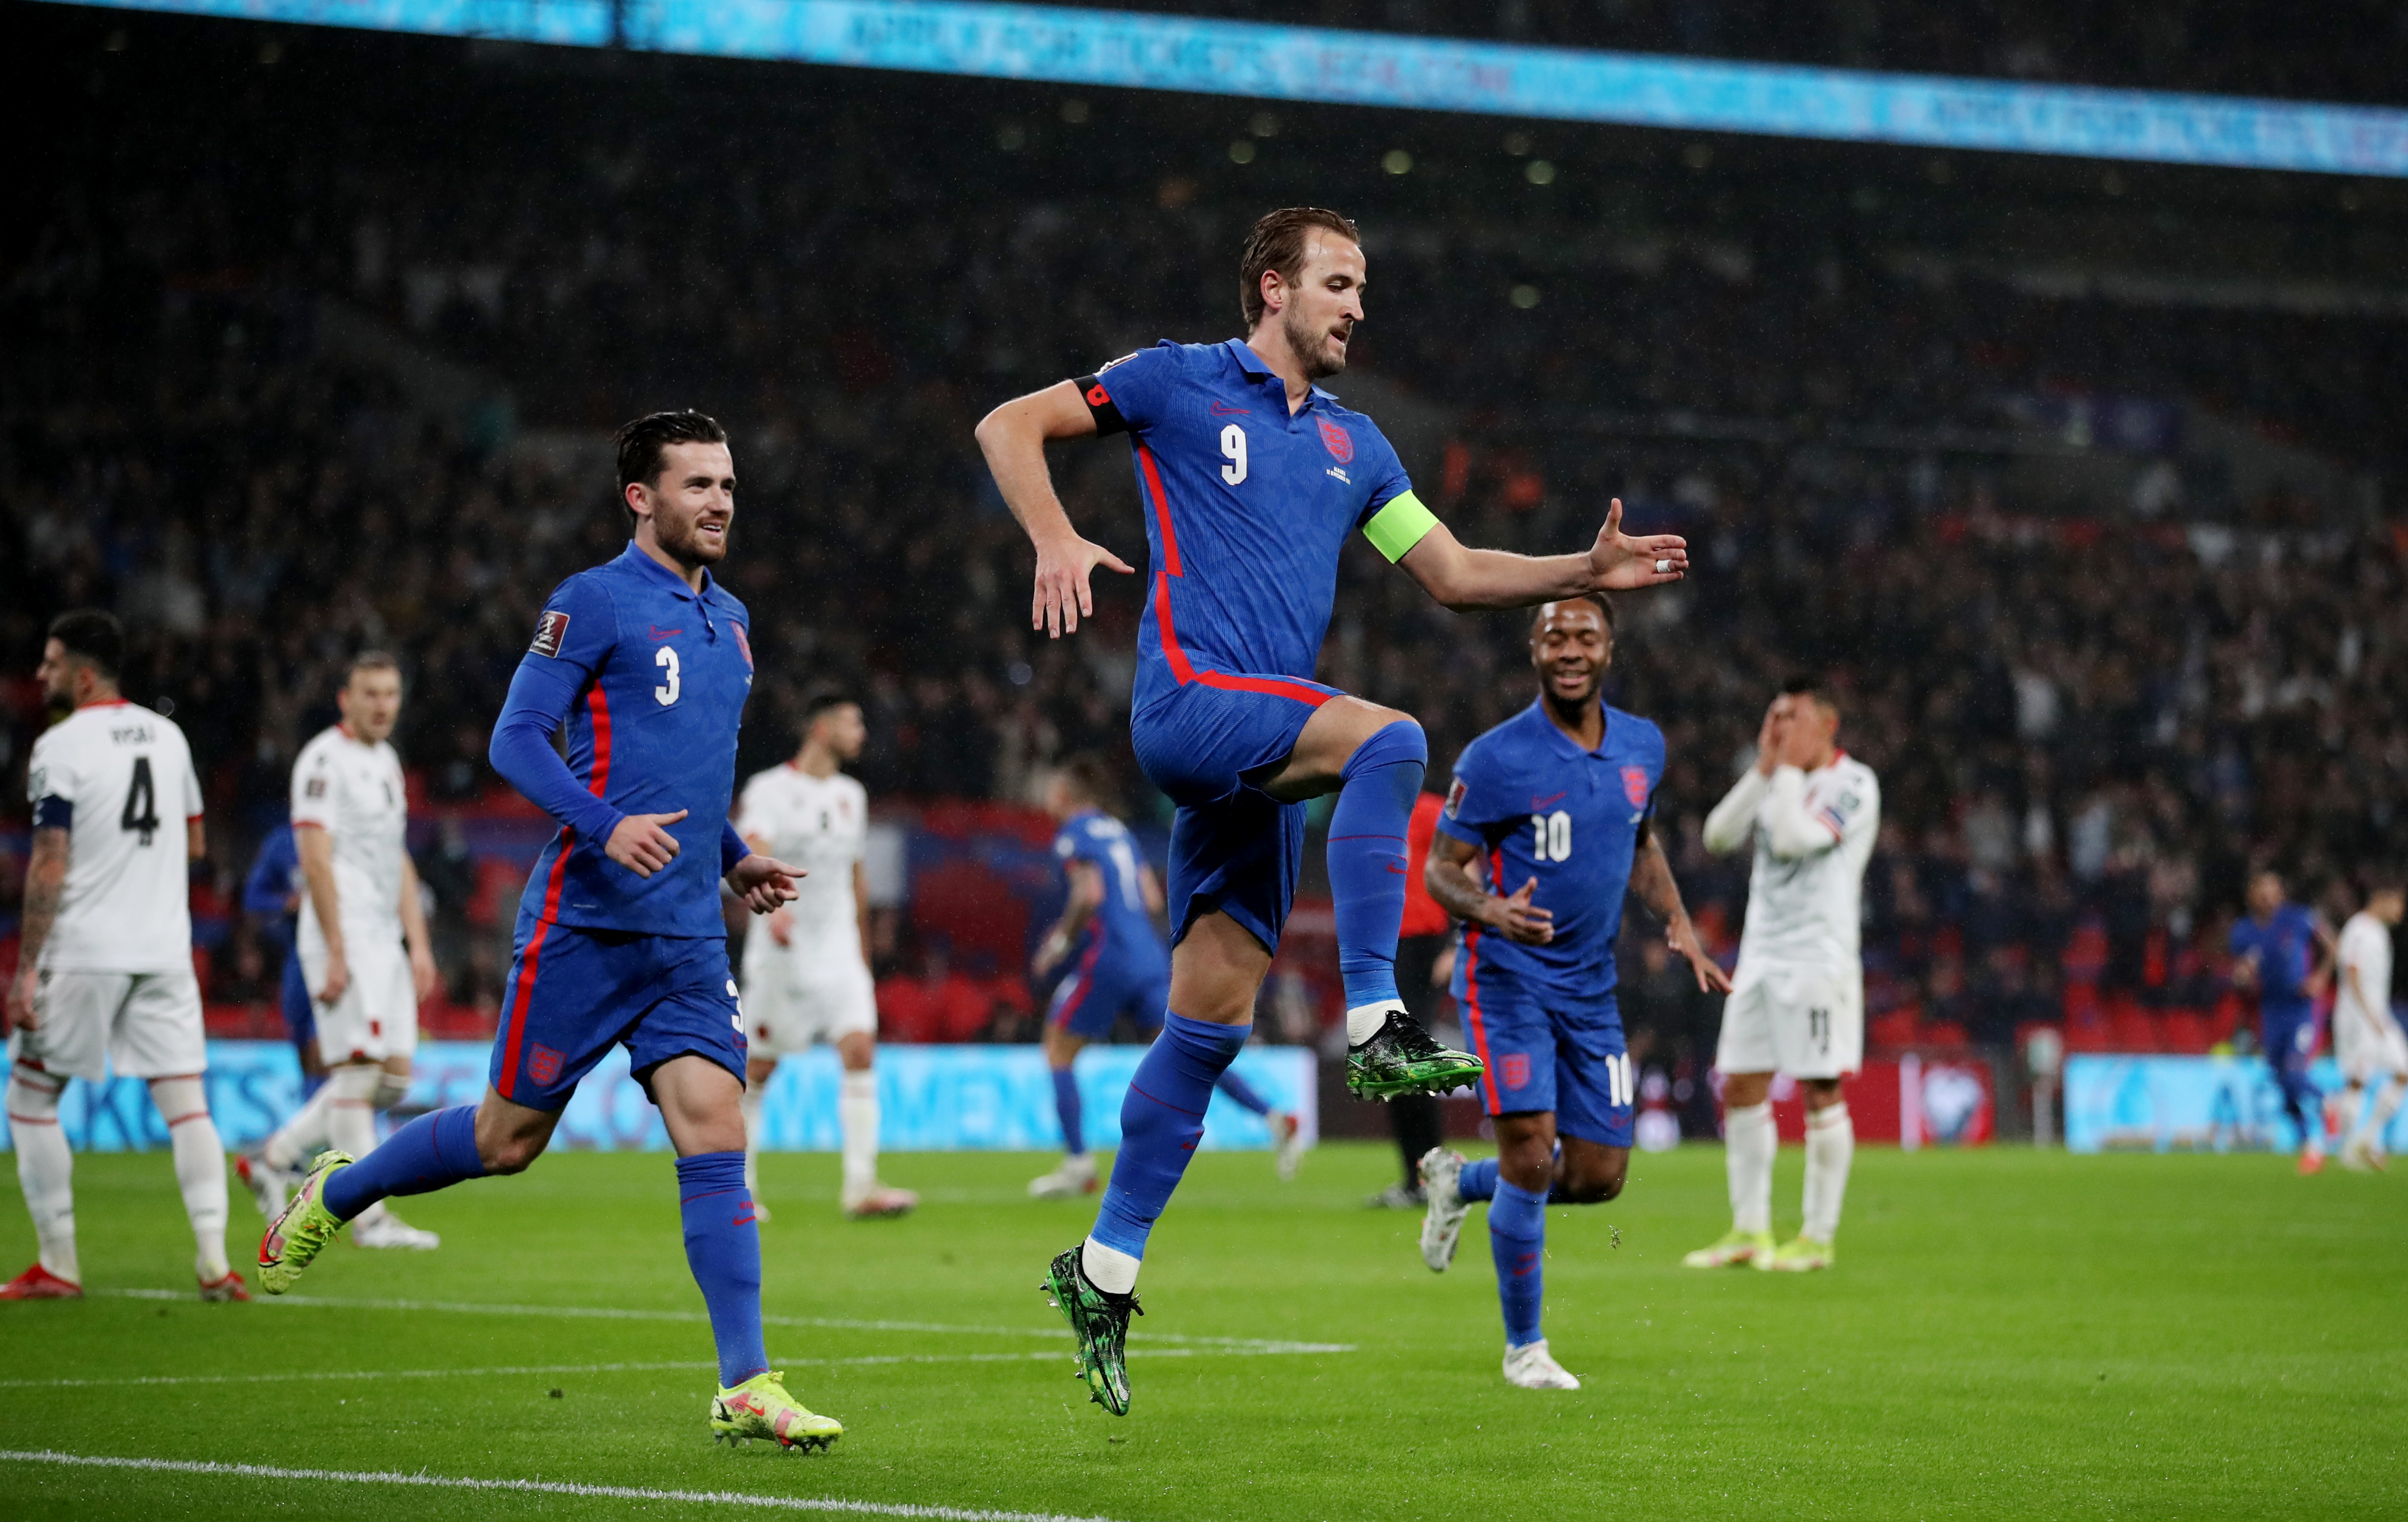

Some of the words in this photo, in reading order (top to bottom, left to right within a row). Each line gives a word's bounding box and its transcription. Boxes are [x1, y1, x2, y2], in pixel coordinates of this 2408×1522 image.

[1221, 424, 1247, 486] 9
[655, 646, 680, 706] 3
[122, 757, 161, 845] 4
[1531, 810, 1571, 862] 10
[726, 979, 745, 1034] 3
[1605, 1052, 1633, 1106] 10
